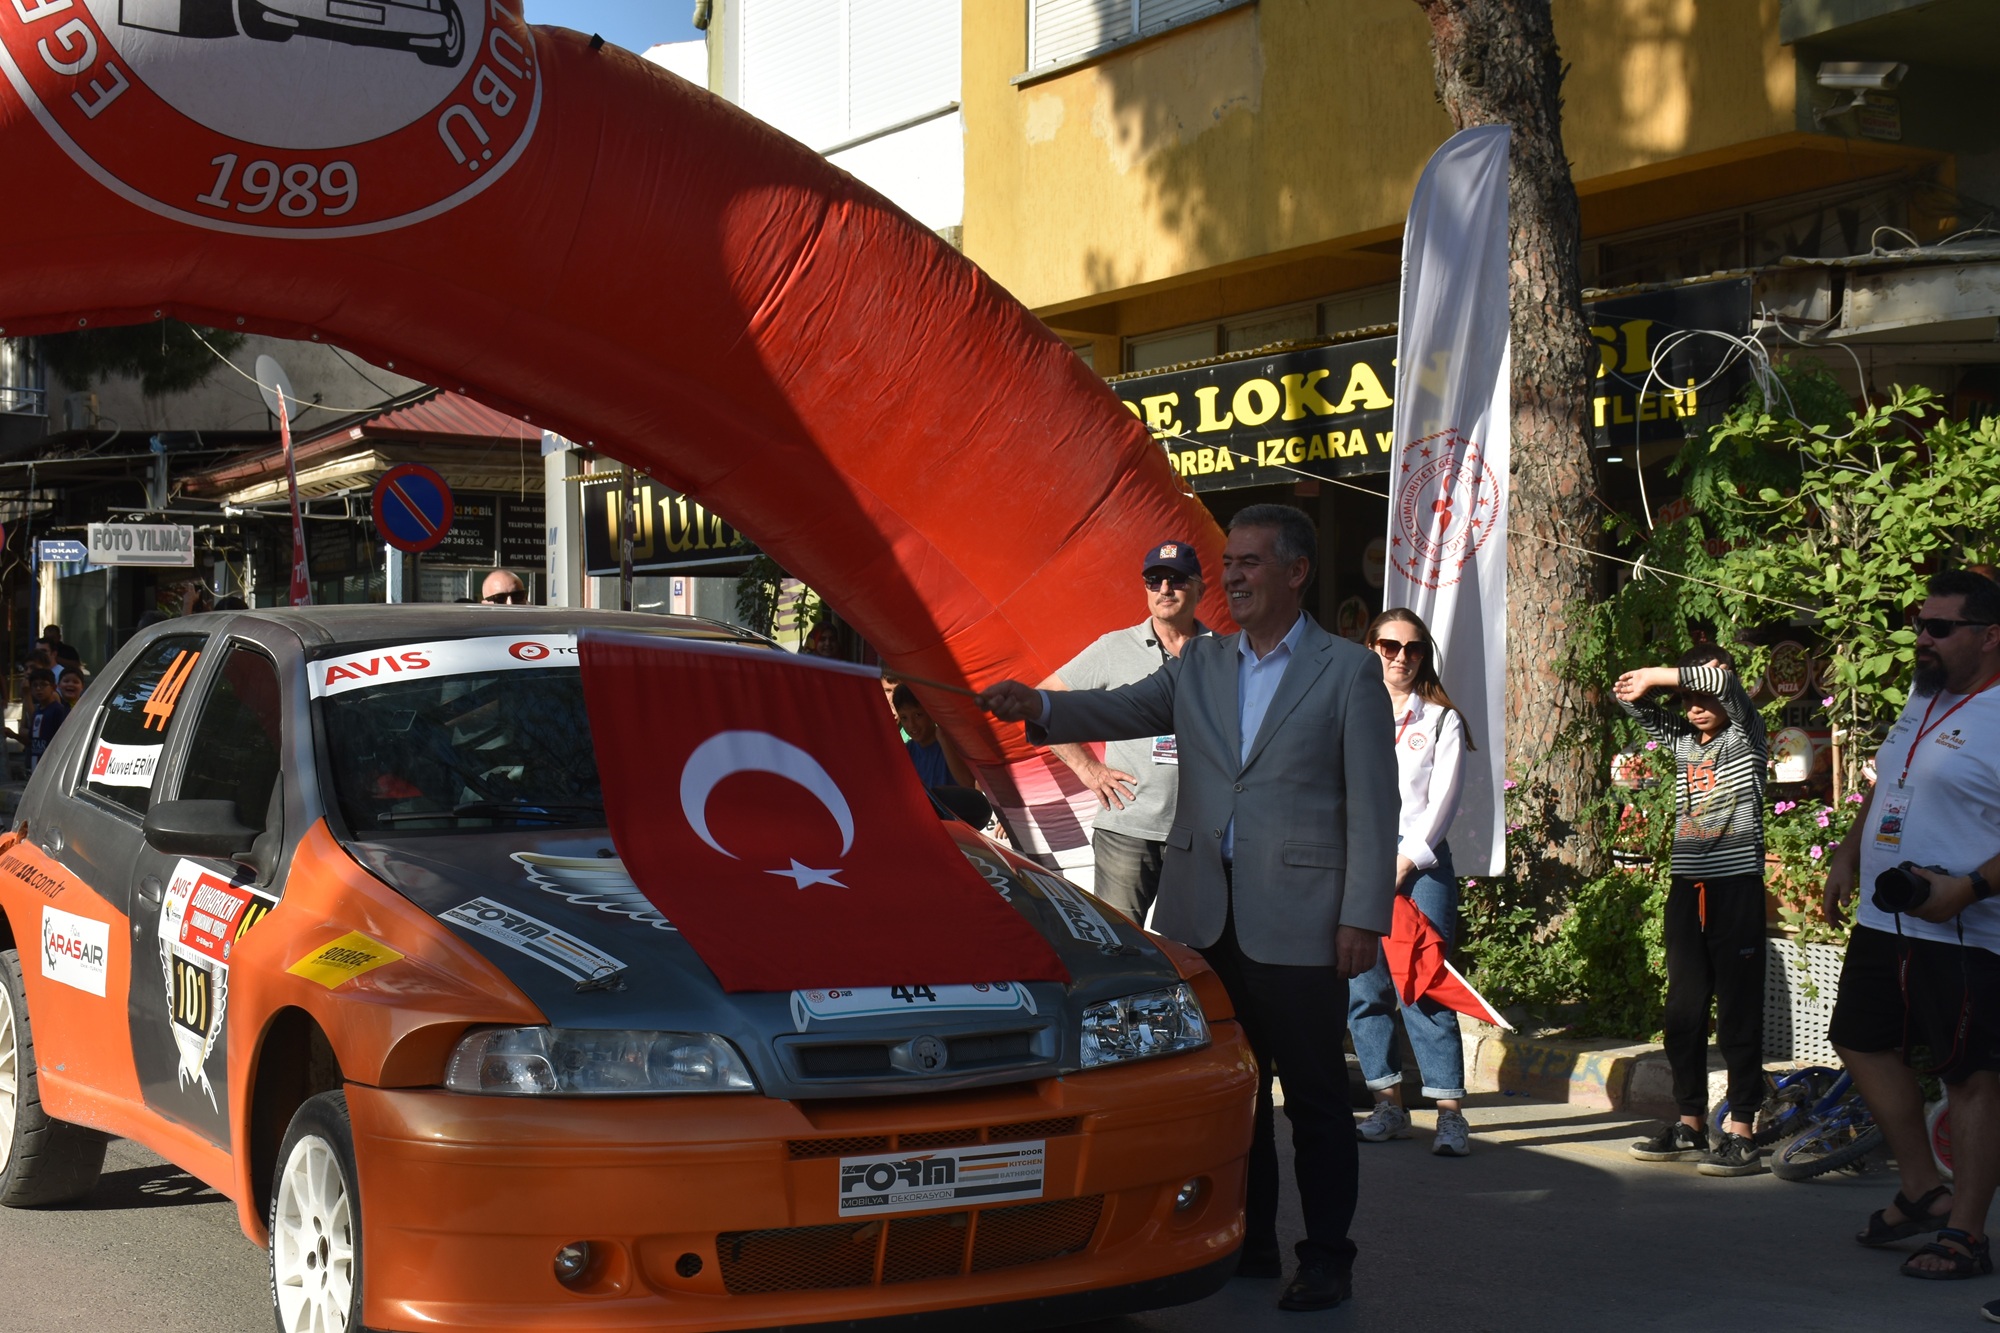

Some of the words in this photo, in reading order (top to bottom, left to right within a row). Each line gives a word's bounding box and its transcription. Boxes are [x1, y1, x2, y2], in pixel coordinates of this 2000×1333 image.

[195, 152, 360, 218] 1989
[1194, 358, 1397, 433] LOKA
[1257, 428, 1369, 468] IZGARA
[92, 528, 133, 551] FOTO
[136, 528, 192, 553] YILMAZ
[508, 521, 532, 529] TELEFON
[325, 651, 431, 686] AVIS
[143, 650, 201, 731] 44
[107, 757, 134, 775] Kuvvet
[133, 754, 156, 776] ERİM
[170, 877, 192, 898] AVIS
[191, 883, 245, 923] BUHARKENT
[458, 901, 551, 940] FORM
[49, 932, 103, 967] ARASAIR
[177, 961, 207, 1031] 101
[1008, 1158, 1043, 1168] KITCHEN
[1021, 1148, 1043, 1157] DOOR
[841, 1157, 956, 1193] FORM
[999, 1168, 1043, 1179] BATHROOM
[842, 1196, 884, 1208] MOBİLYA
[890, 1190, 953, 1203] DEKORASYON
